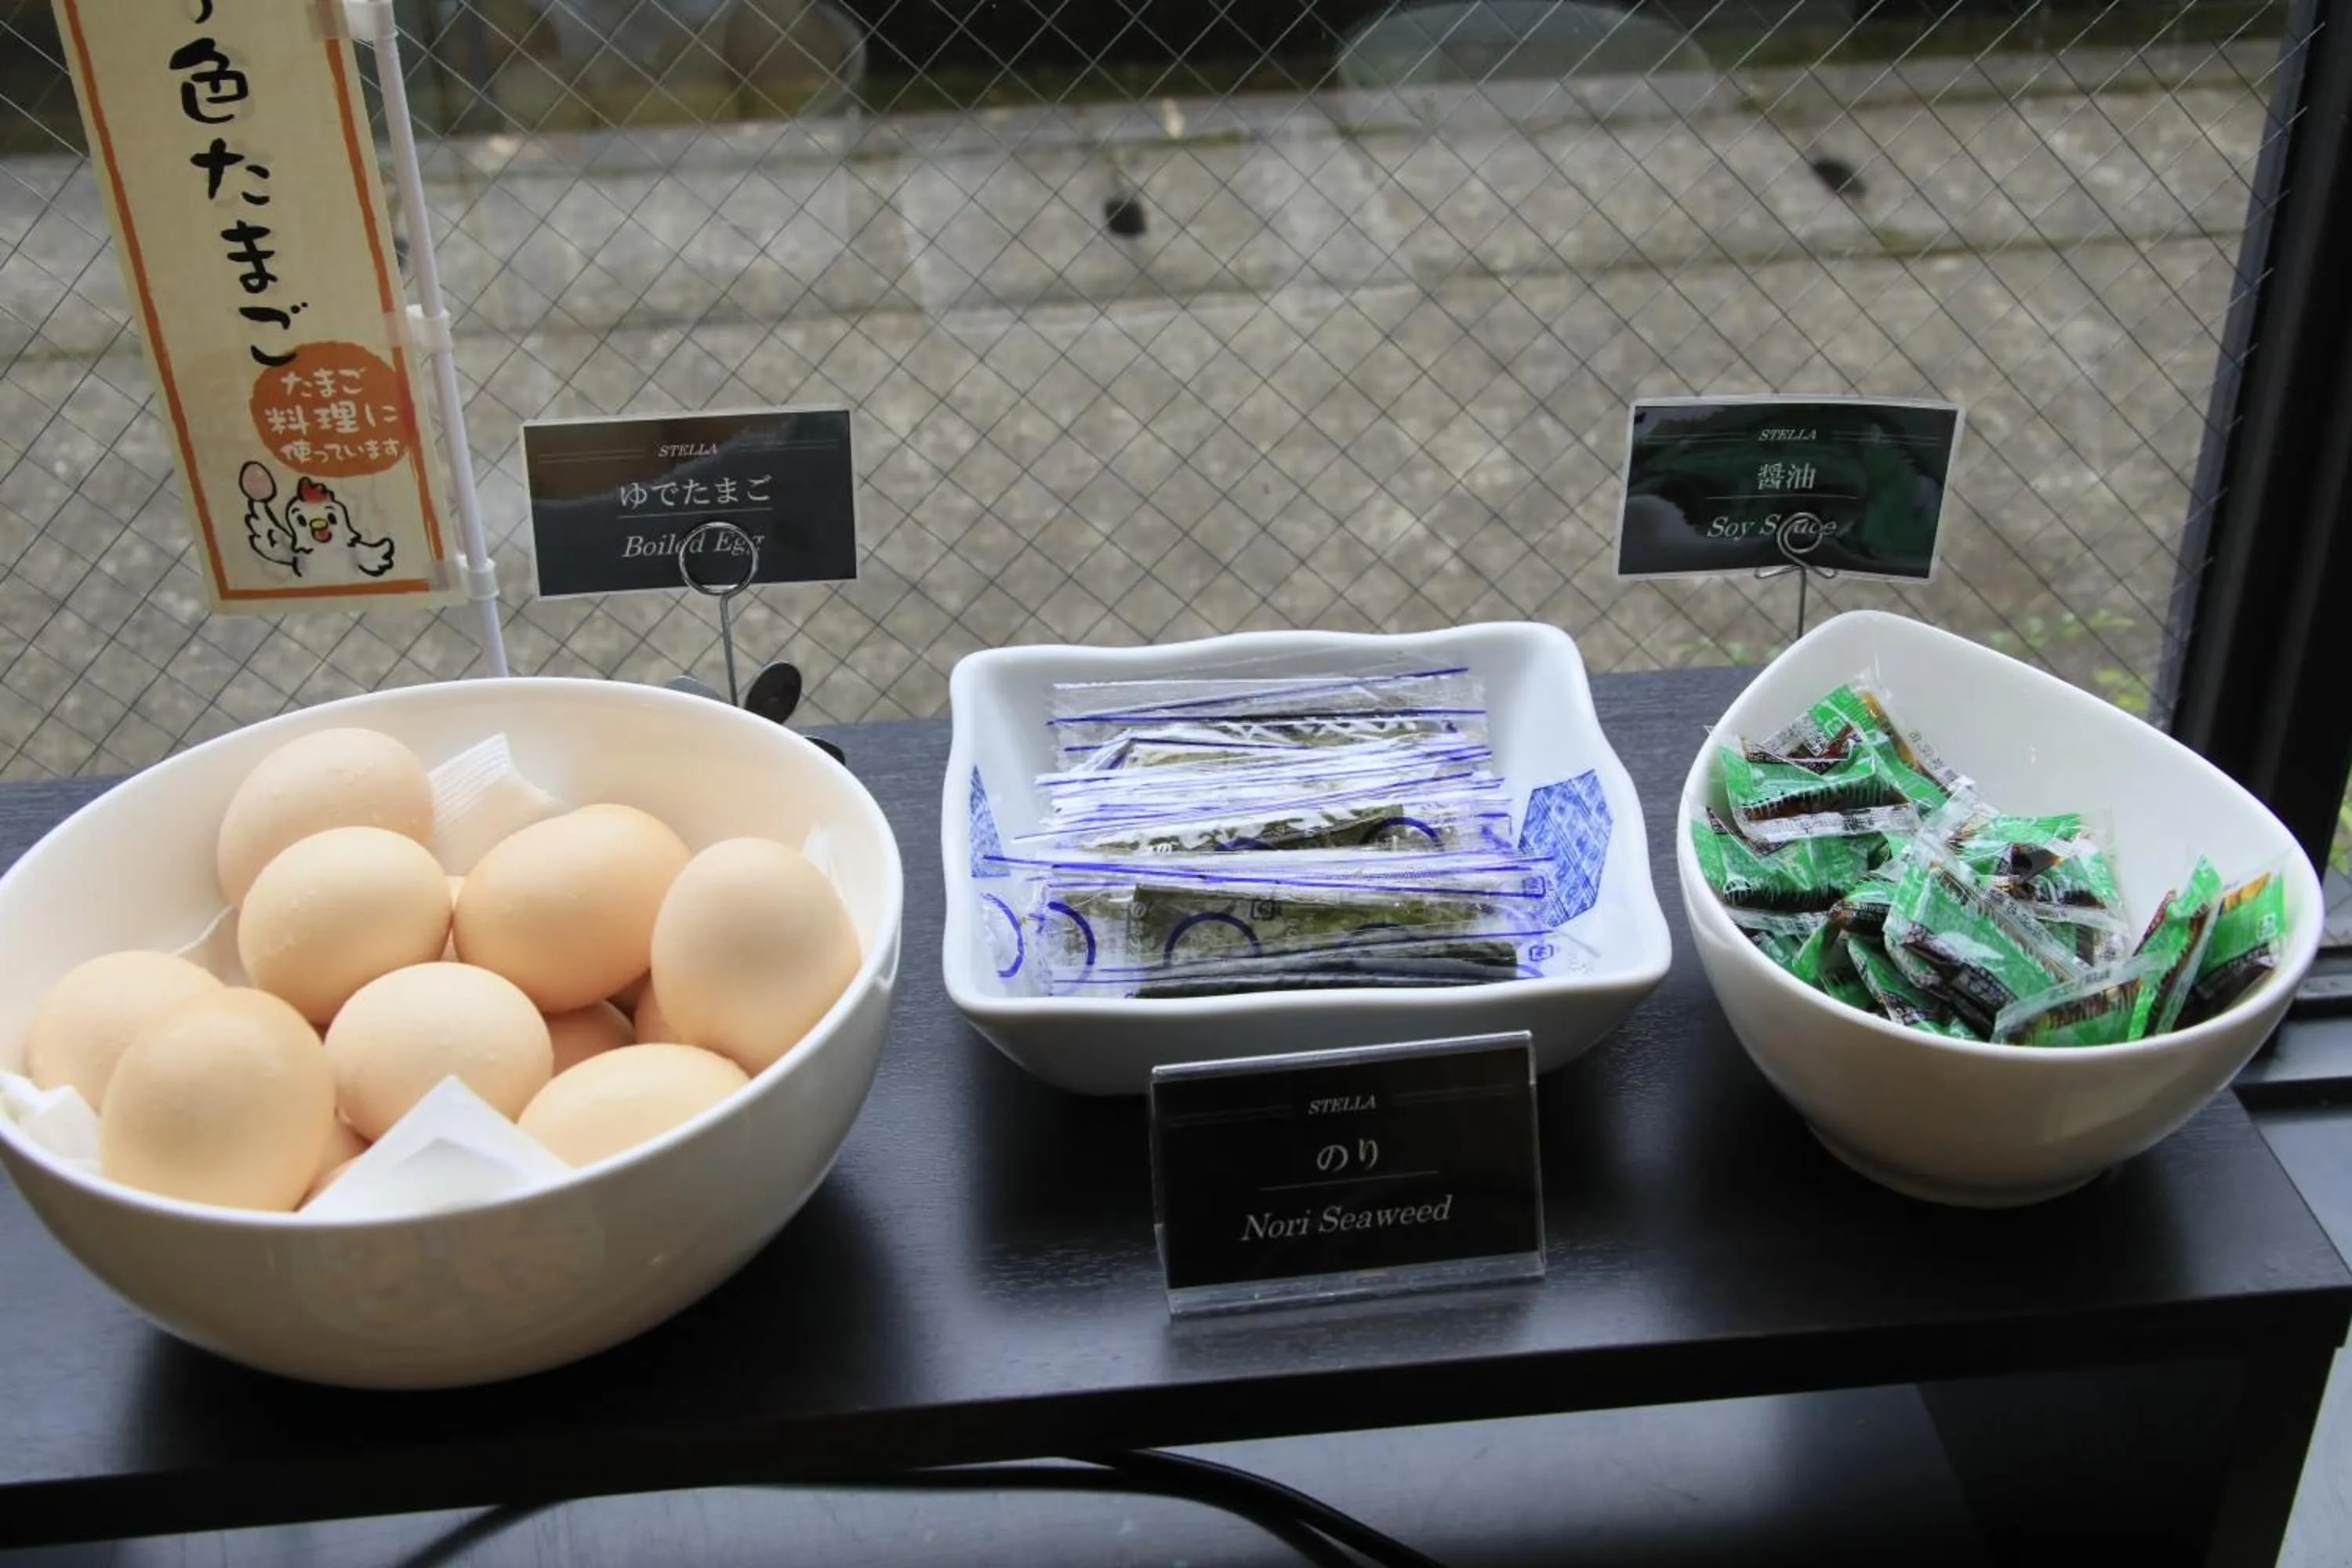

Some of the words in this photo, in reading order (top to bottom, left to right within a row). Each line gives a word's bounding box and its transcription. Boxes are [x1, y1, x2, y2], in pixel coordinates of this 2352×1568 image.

[169, 0, 308, 367] 色たまご
[279, 367, 367, 397] たまご
[263, 400, 399, 436] 料理に
[1758, 428, 1817, 441] STELLA
[279, 437, 400, 464] 使っています
[657, 442, 719, 458] STELLA
[618, 474, 772, 510] ゆでたまご
[1706, 516, 1755, 541] Soy
[1308, 1094, 1377, 1116] STELLA
[1316, 1138, 1380, 1171] のり
[1241, 1208, 1310, 1242] Nori
[1318, 1194, 1454, 1233] Seaweed
